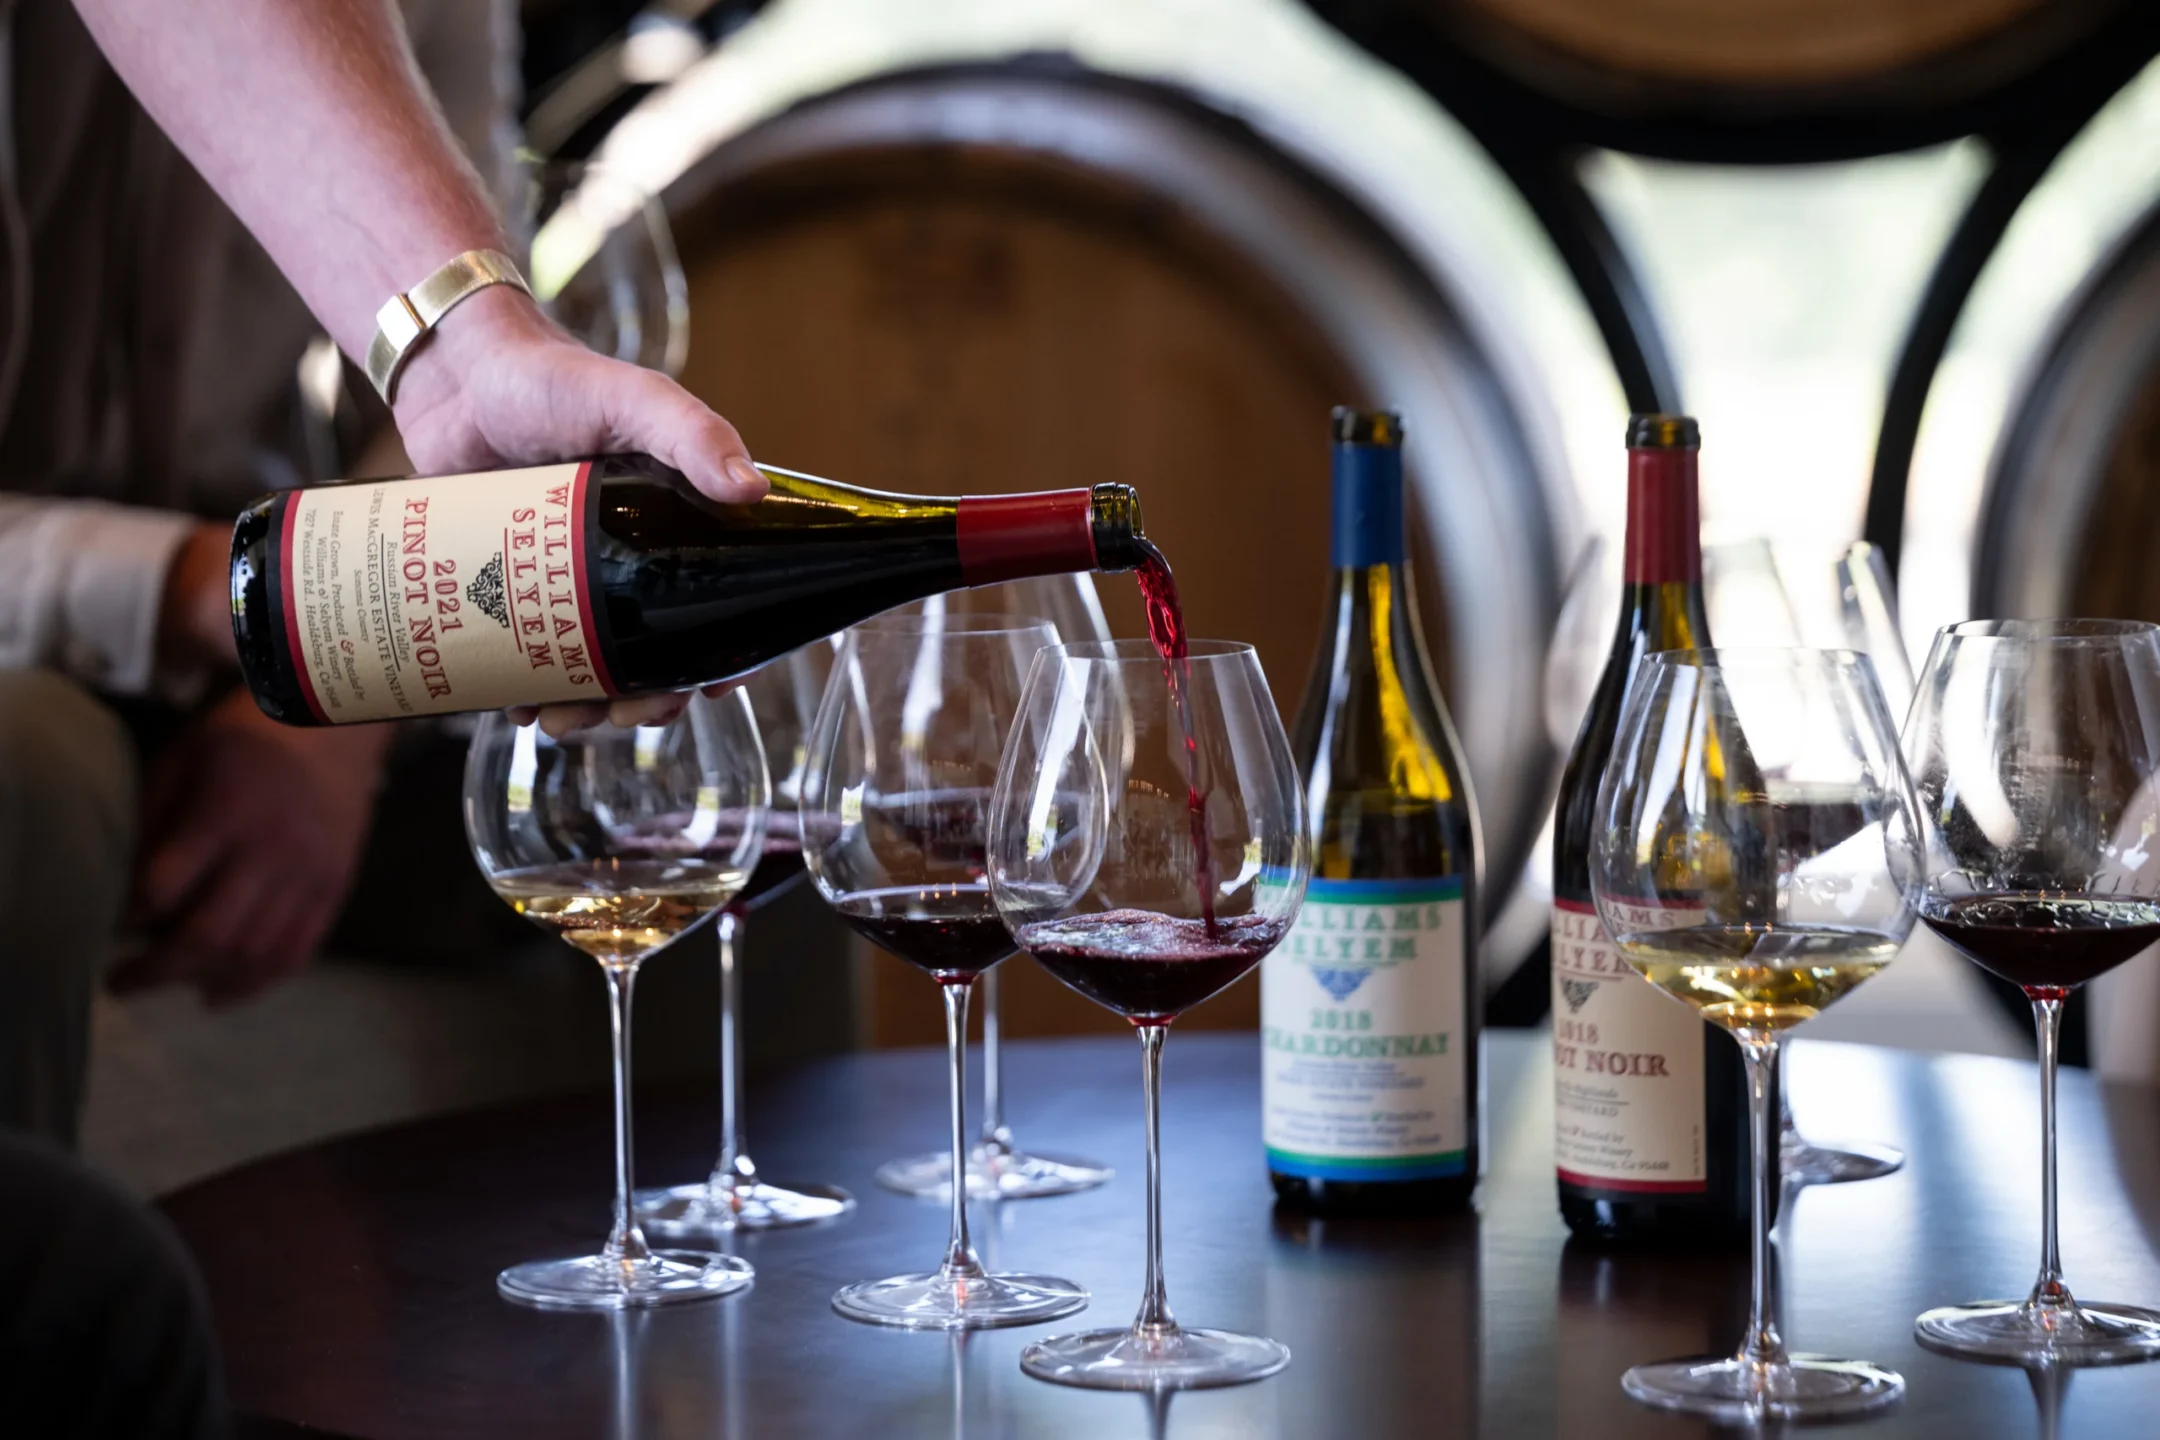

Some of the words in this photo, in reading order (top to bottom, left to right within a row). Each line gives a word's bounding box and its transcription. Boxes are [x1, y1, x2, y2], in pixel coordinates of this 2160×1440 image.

[316, 536, 328, 585] Williams
[387, 541, 398, 588] Russian
[403, 497, 430, 605] PINOT
[332, 583, 349, 636] Produced
[390, 591, 401, 624] River
[433, 559, 464, 634] 2021
[512, 508, 555, 670] SELYEM
[544, 482, 594, 686] WILLIAMS
[320, 602, 333, 642] Selyem
[372, 608, 392, 662] ESTATE
[395, 627, 410, 663] Valley
[409, 616, 452, 700] NOIR
[1300, 904, 1442, 931] LLIAMS
[1585, 1049, 1670, 1078] NOIR
